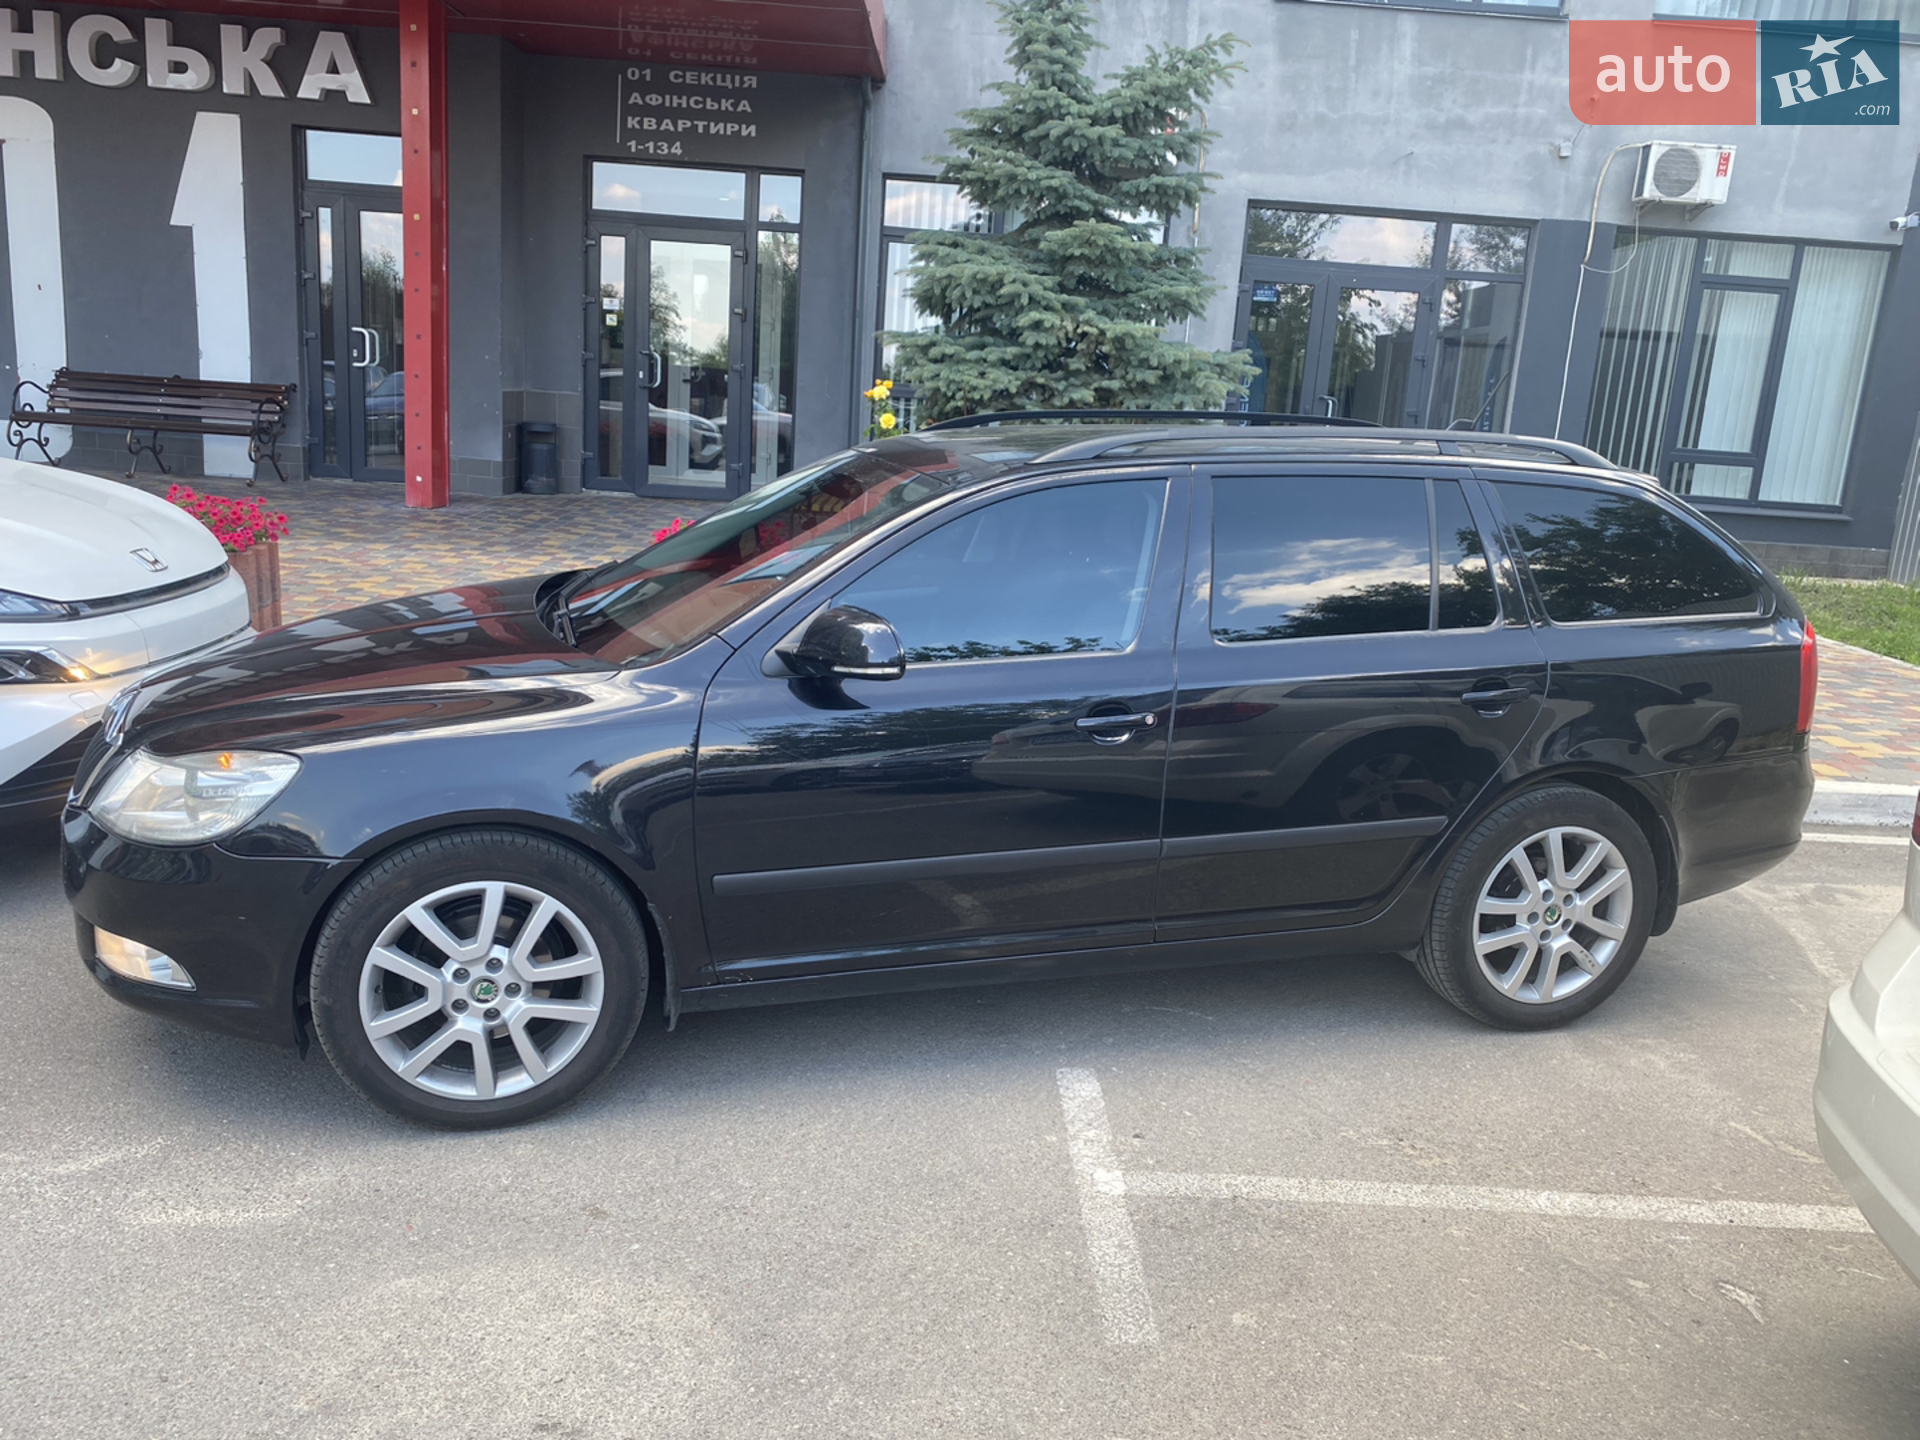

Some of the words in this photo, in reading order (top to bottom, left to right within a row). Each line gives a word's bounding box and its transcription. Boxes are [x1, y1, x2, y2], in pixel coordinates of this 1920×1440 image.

[627, 67, 652, 81] 01
[669, 70, 758, 89] СЕКЦІЯ
[628, 92, 752, 112] АФІНСЬКА
[627, 116, 756, 137] КВАРТИРИ
[627, 140, 683, 155] 1-134
